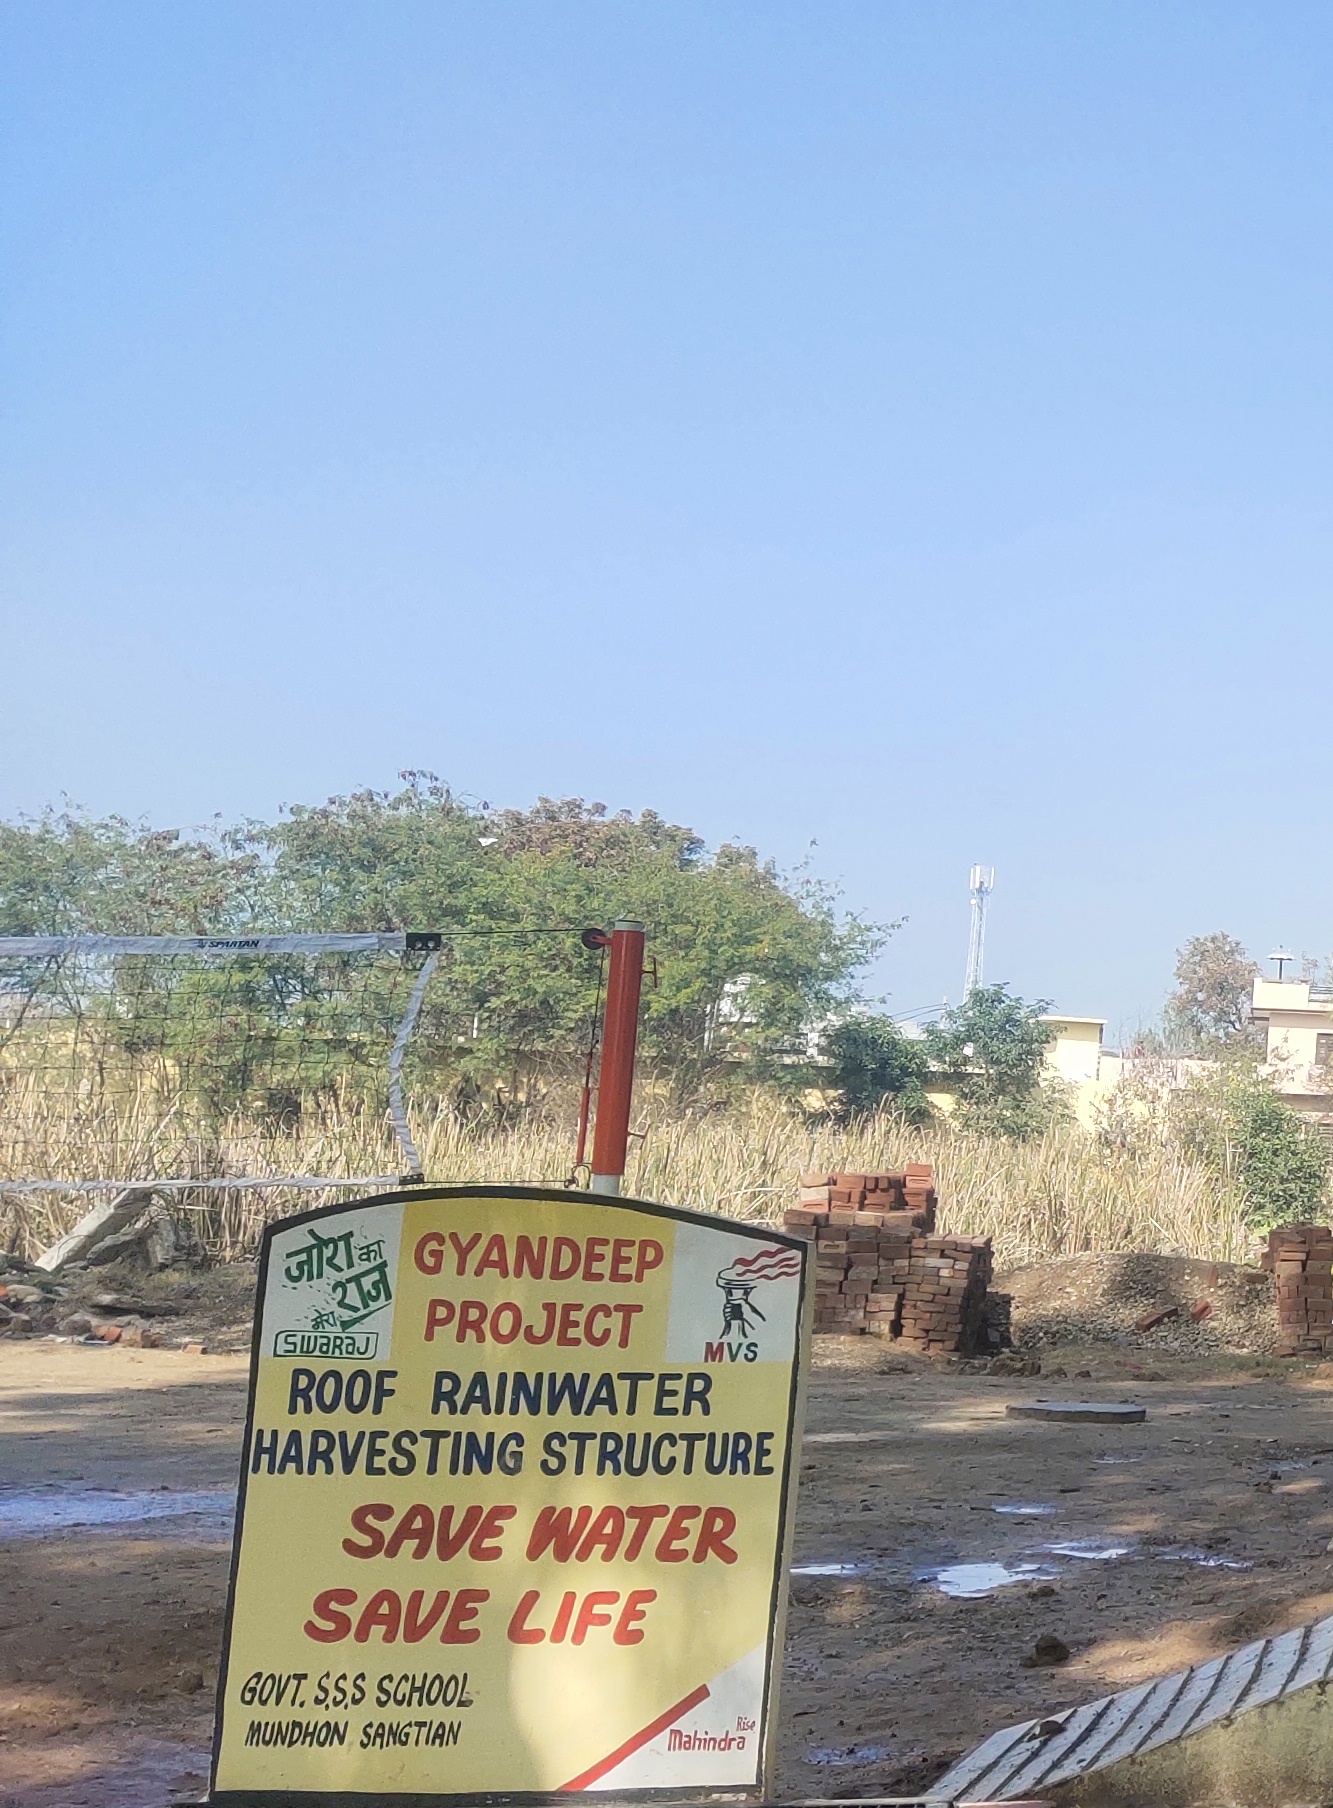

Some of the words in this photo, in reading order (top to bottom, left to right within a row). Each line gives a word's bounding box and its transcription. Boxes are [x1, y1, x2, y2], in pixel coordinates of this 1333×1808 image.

[208, 940, 260, 948] SPARTAN
[357, 1239, 386, 1263] का
[413, 1231, 664, 1284] GYANDEEP
[331, 1259, 393, 1314] राज
[311, 1308, 338, 1330] मेरा
[423, 1299, 643, 1348] PROJECT
[703, 1341, 759, 1363] MVS
[288, 1369, 398, 1415] ROOF
[431, 1371, 713, 1417] RAINWATER
[251, 1430, 525, 1476] HARVESTING
[540, 1432, 775, 1477] STRUCTURE
[342, 1504, 517, 1562] SAVE
[526, 1505, 739, 1564] WATER
[303, 1589, 490, 1646] SAVE
[506, 1590, 657, 1647] LIFE
[240, 1671, 308, 1708] GOVT.
[376, 1672, 474, 1708] SCHOOL
[244, 1720, 349, 1748] MUNDHON
[360, 1720, 462, 1750] SANGTIAN
[667, 1728, 746, 1752] Mahindra
